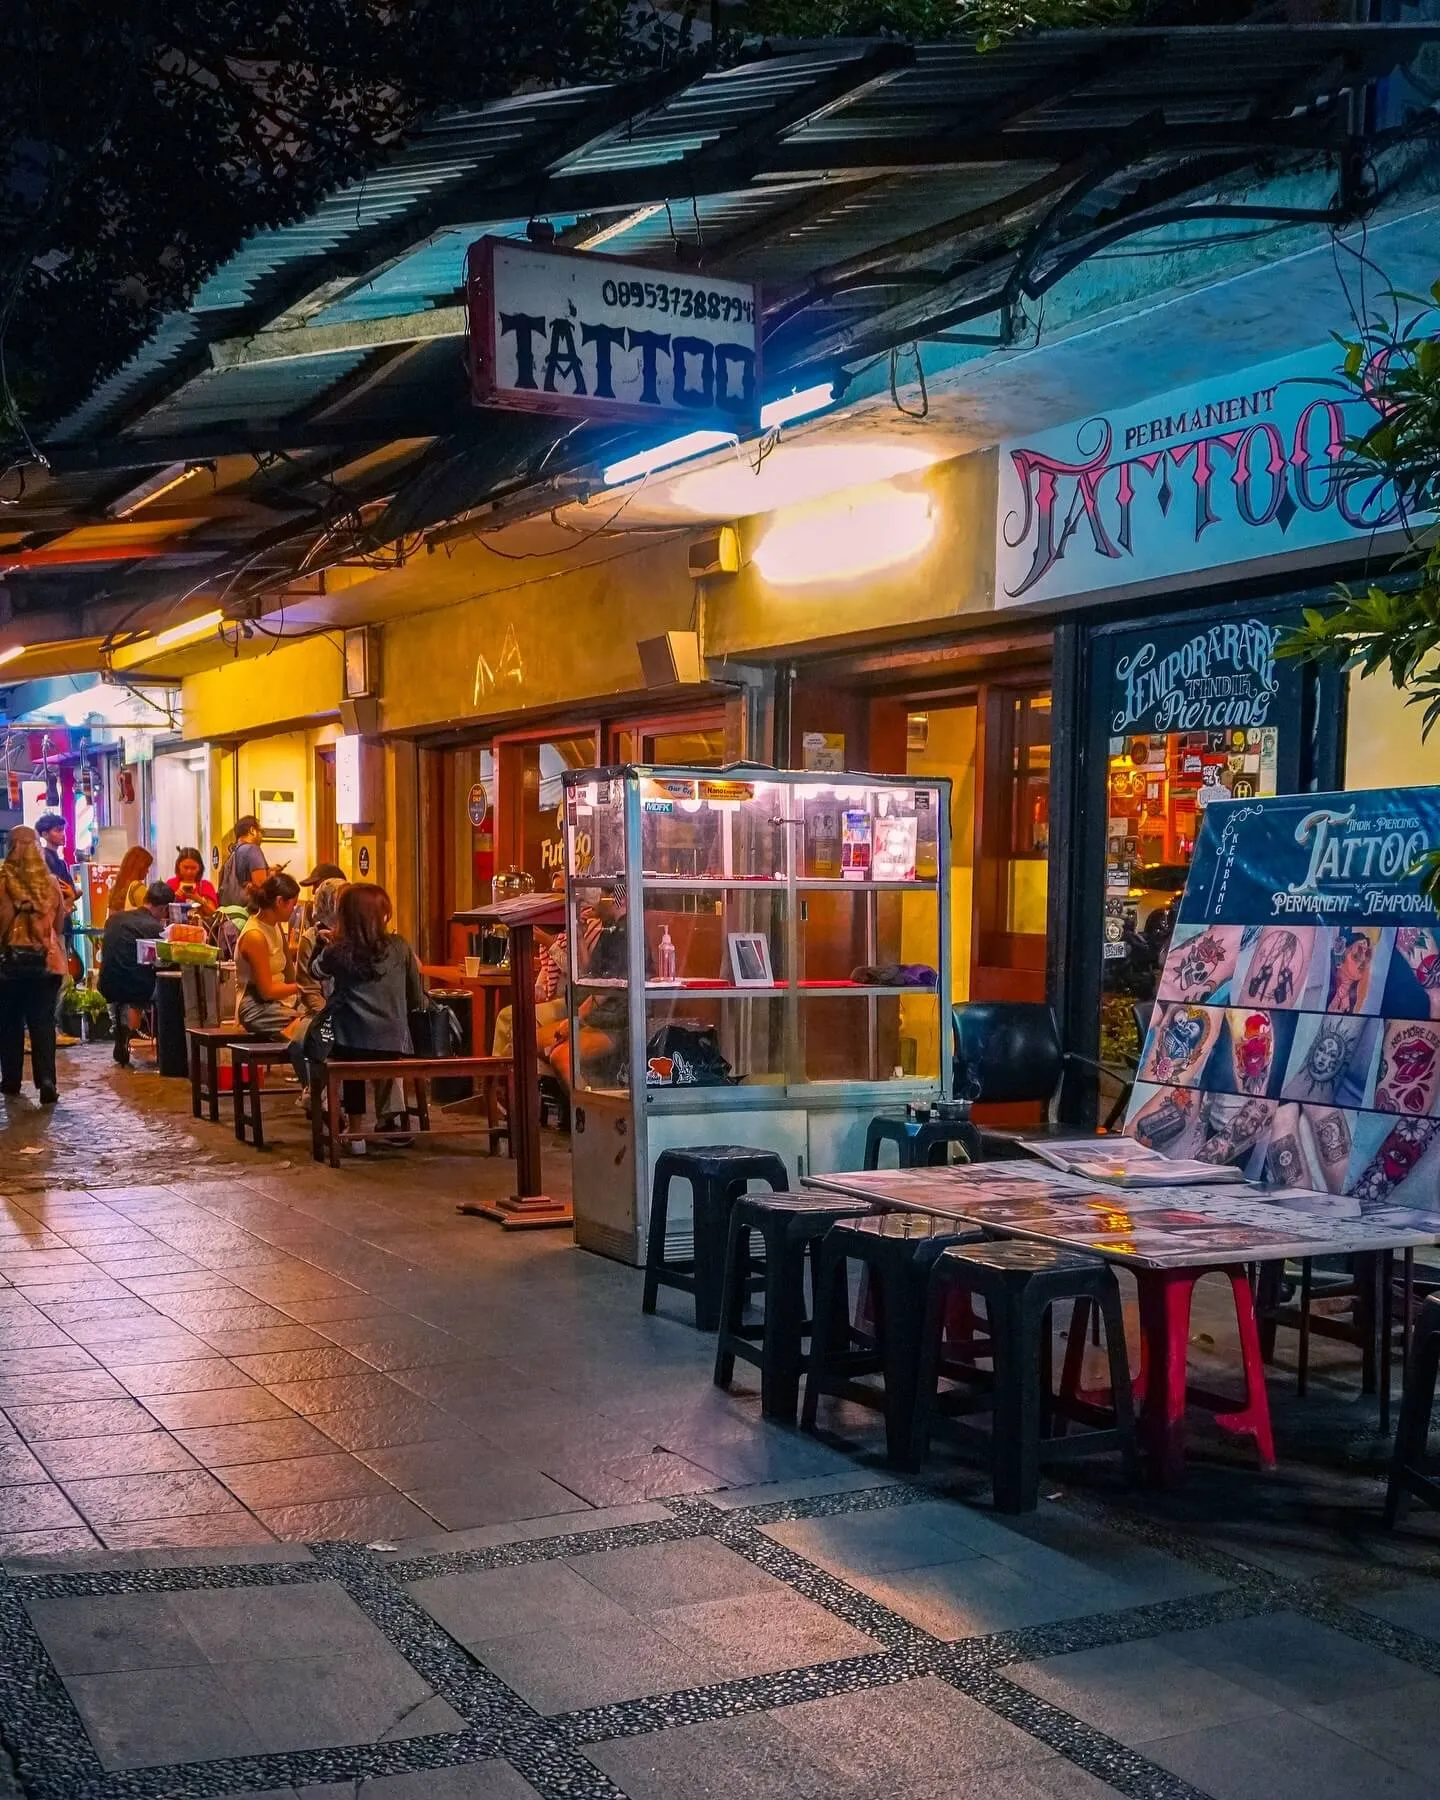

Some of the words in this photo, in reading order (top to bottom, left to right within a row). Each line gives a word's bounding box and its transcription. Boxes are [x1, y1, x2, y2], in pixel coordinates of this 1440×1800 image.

[499, 312, 755, 414] TATTOO
[1125, 386, 1278, 450] PERMANENT
[1185, 673, 1257, 699] TINDIK
[1215, 833, 1239, 915] KEMBANG
[1270, 892, 1352, 916] PERMANENT
